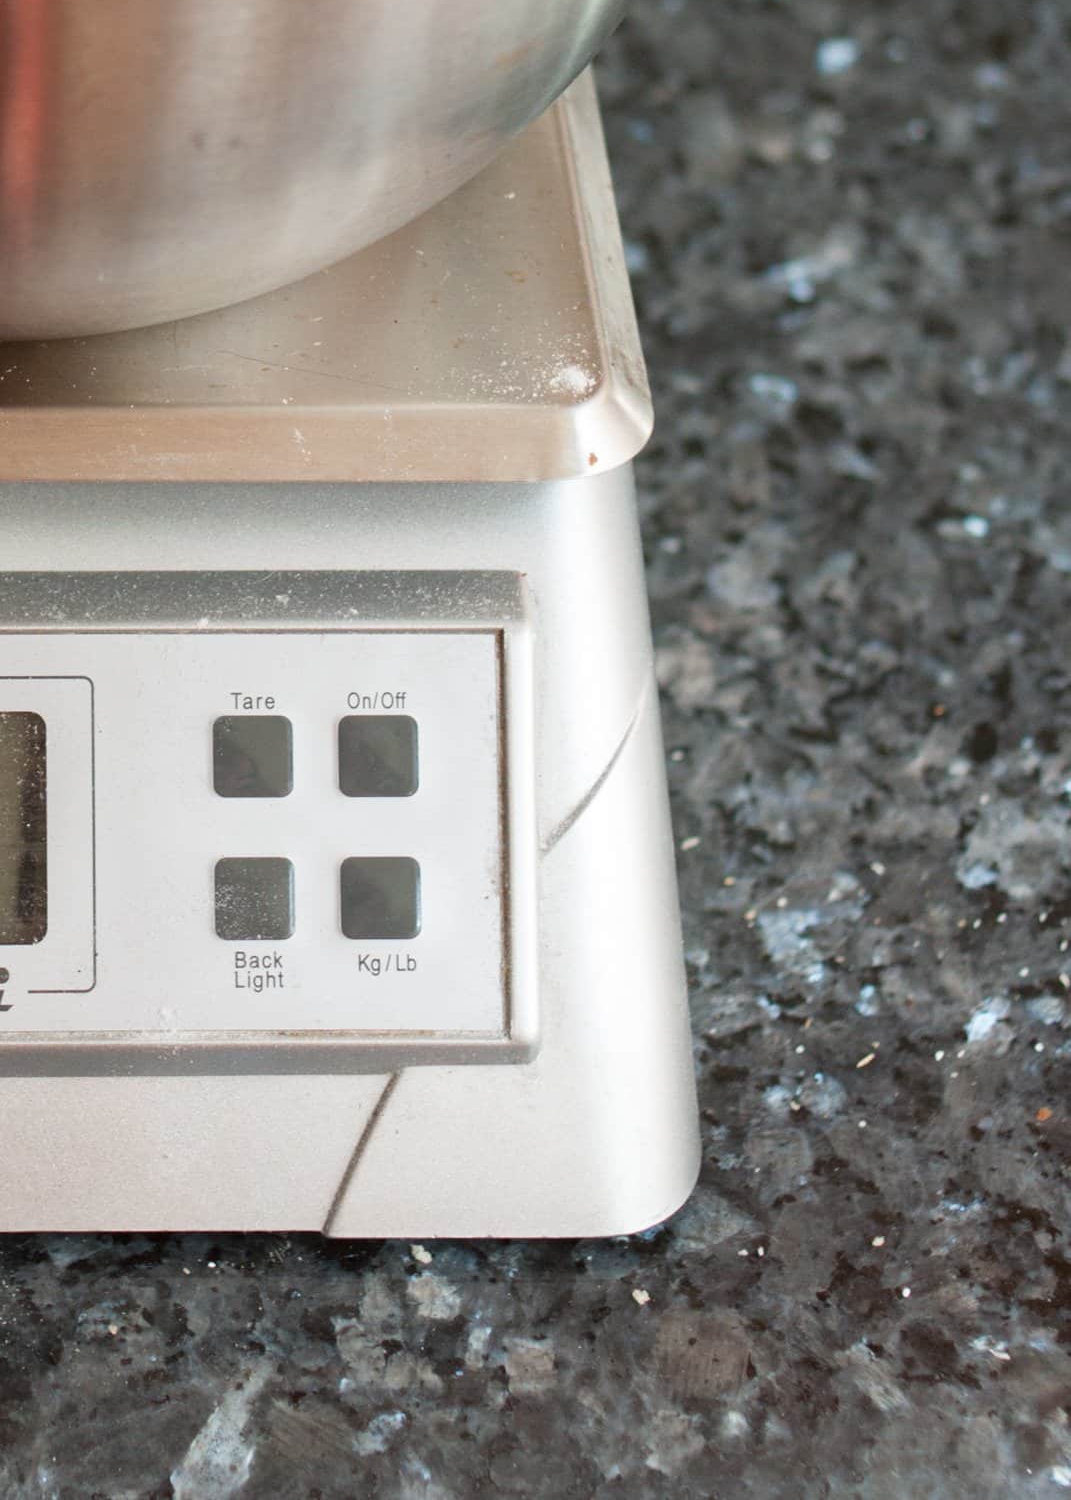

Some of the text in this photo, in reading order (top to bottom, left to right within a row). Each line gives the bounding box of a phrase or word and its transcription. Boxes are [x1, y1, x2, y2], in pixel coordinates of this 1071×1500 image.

[230, 692, 275, 710] Tare
[346, 691, 407, 710] On/Off
[234, 951, 284, 969] Back
[234, 971, 285, 994] Light
